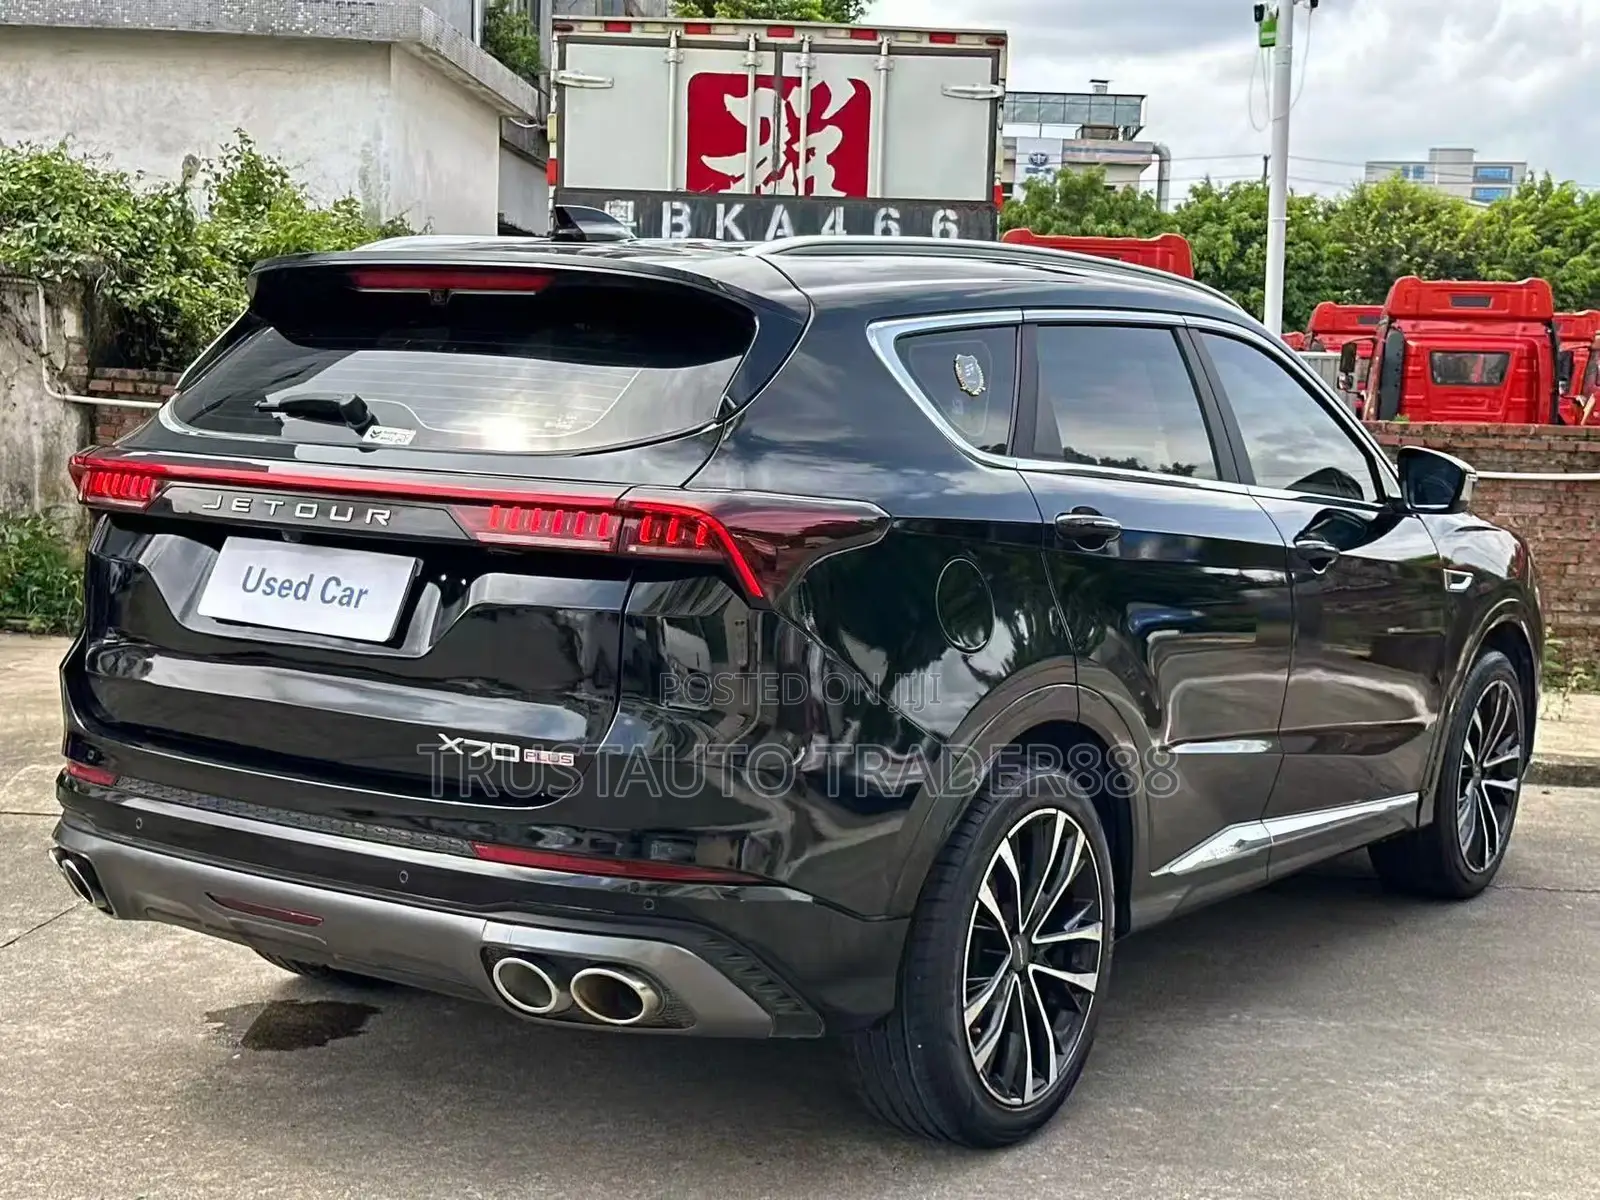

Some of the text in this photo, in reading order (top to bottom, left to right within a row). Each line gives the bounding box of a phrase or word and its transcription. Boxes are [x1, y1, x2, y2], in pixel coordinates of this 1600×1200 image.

[202, 495, 392, 526] JETOUR
[241, 566, 369, 609] Used Car
[438, 733, 573, 764] X70 PLUS
